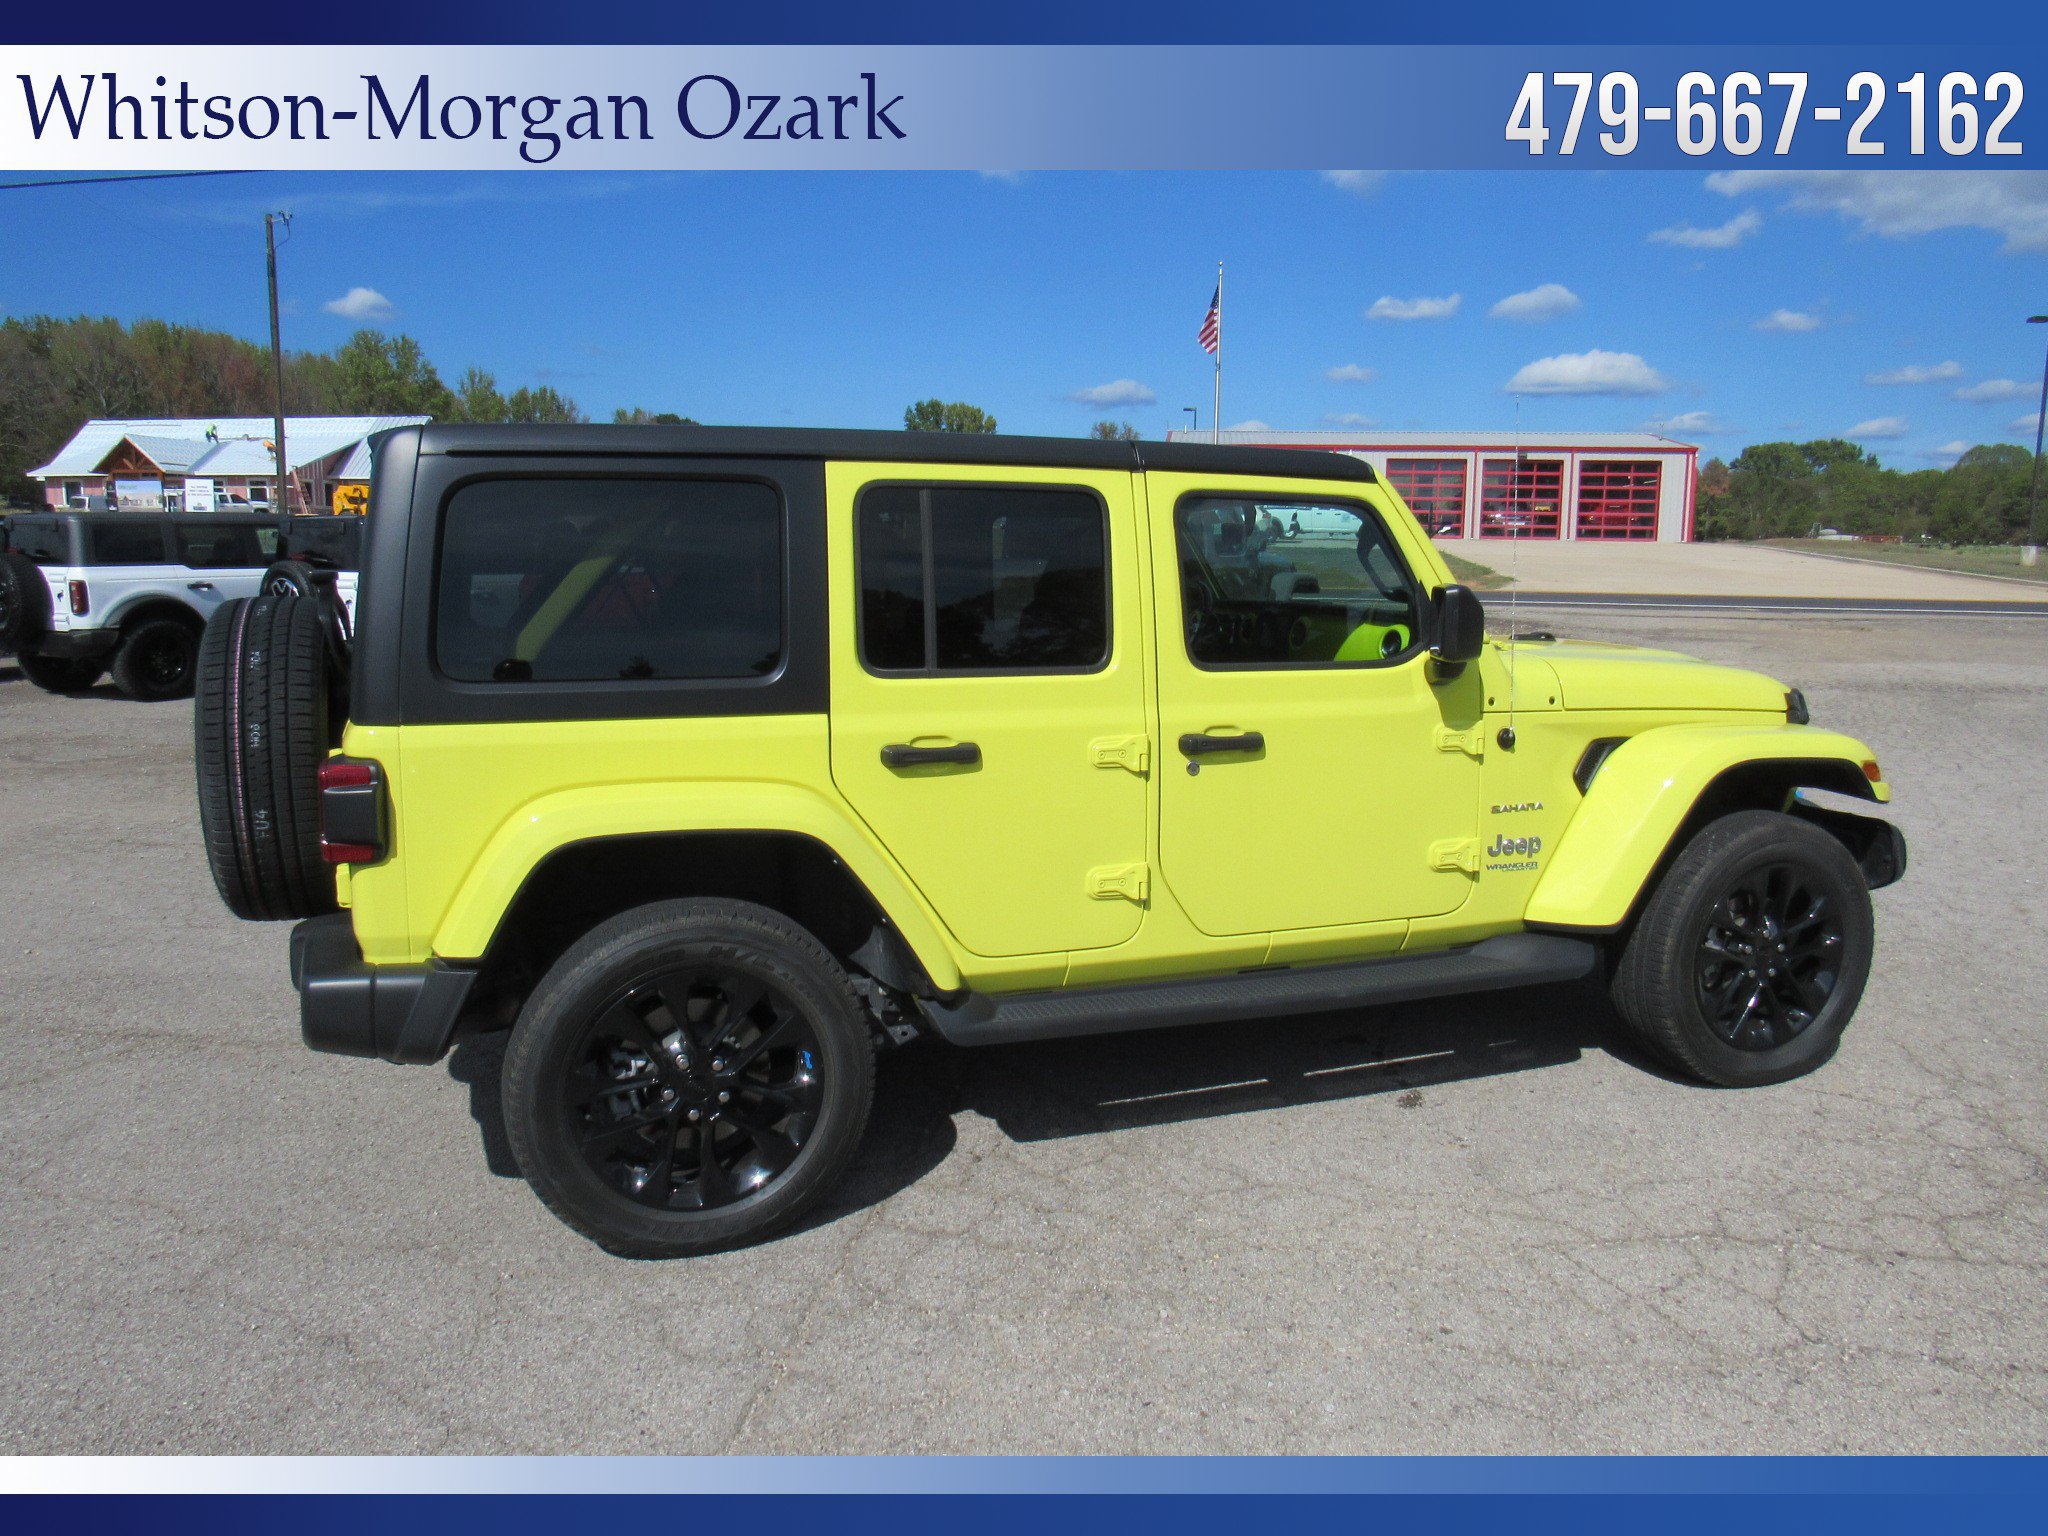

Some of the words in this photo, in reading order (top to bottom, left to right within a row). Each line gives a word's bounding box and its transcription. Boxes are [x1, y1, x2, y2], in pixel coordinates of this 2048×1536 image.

[1491, 802, 1543, 814] SAHARA
[1487, 834, 1541, 858] Jeep
[1486, 862, 1538, 870] WRANGLER
